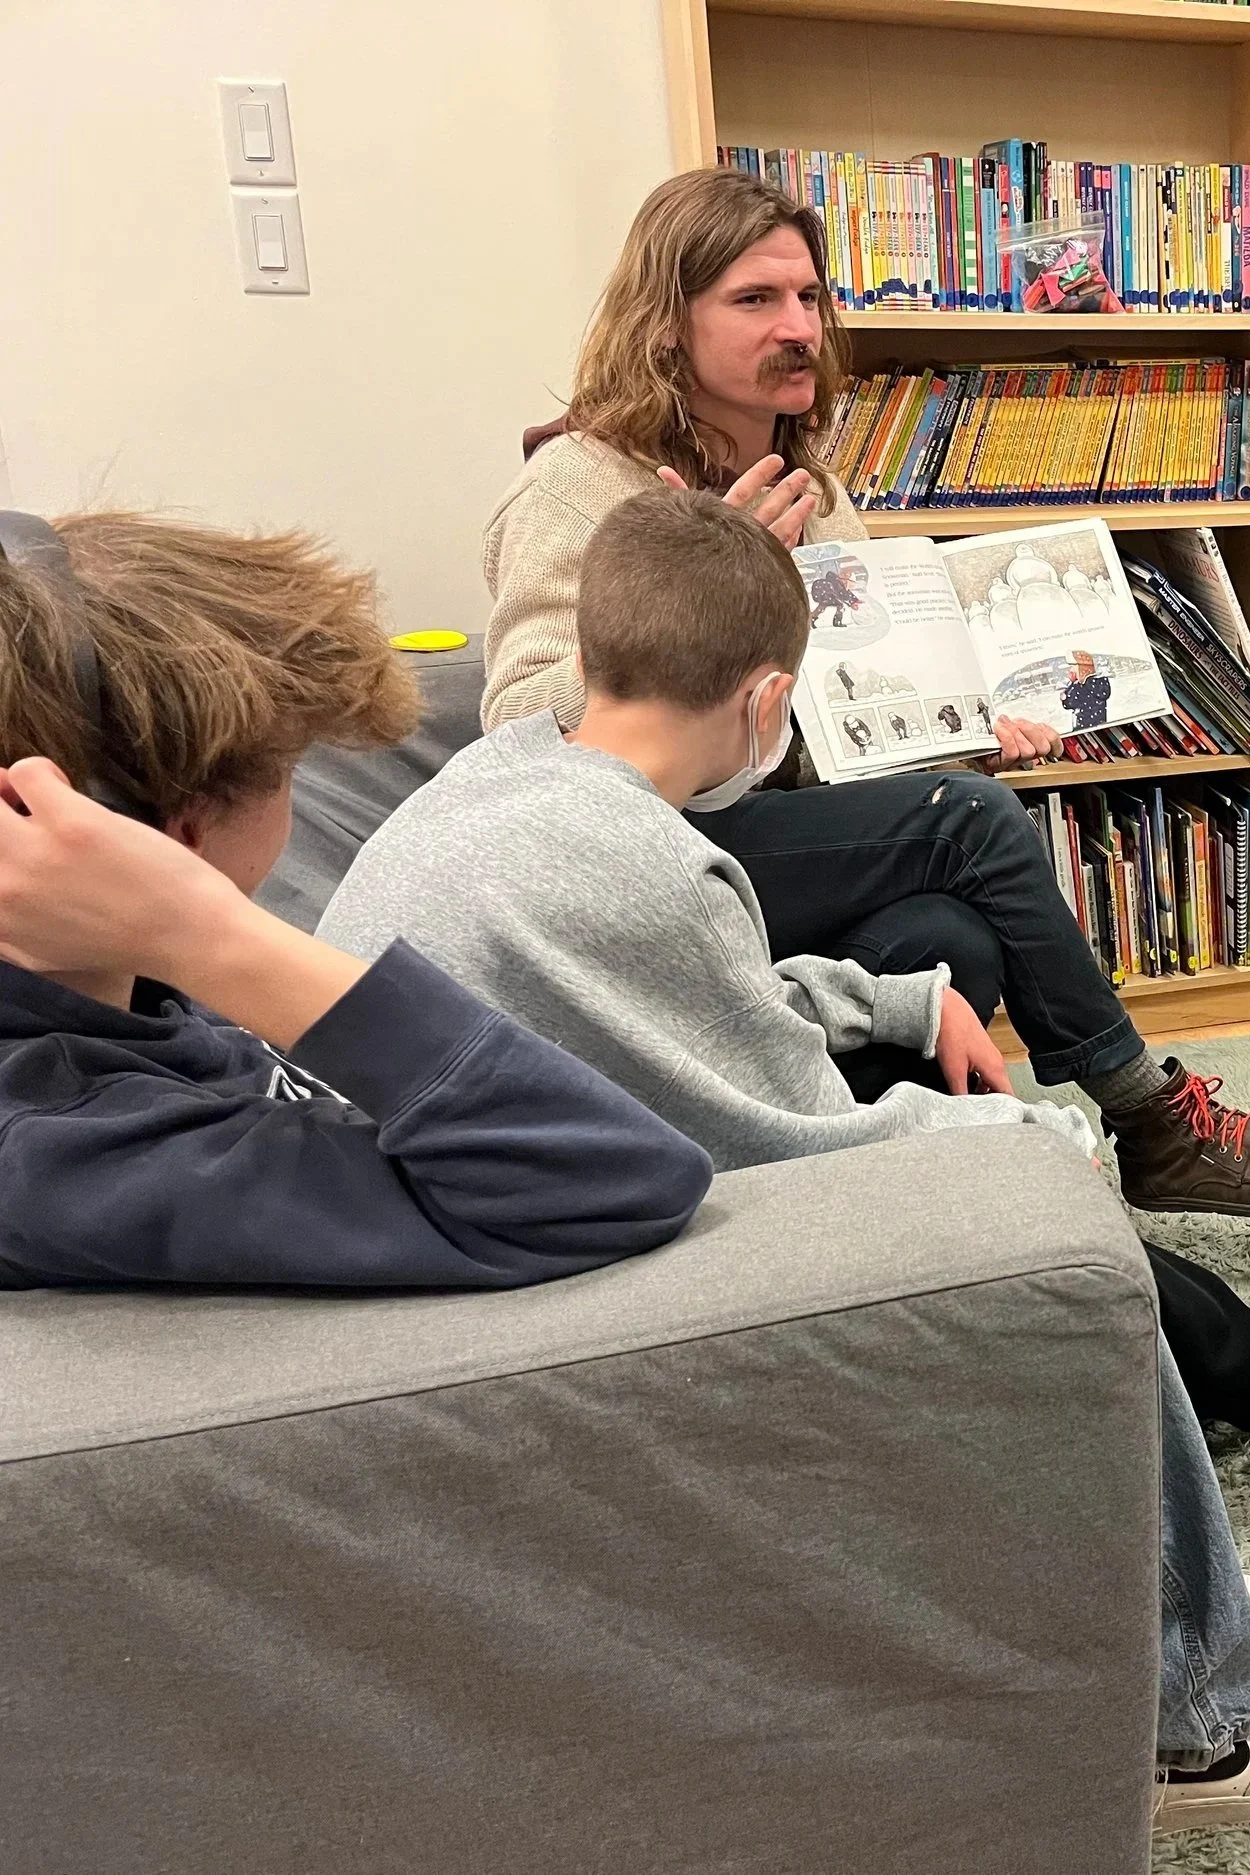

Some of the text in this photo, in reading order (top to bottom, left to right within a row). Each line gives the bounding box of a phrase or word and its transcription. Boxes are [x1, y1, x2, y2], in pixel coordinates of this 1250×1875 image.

[862, 237, 871, 254] Fudge
[1158, 585, 1181, 613] MASTER
[1178, 610, 1205, 643] ENGINEER
[1166, 618, 1204, 660] DINOSAURS
[1205, 640, 1248, 692] SKYSCRAPERS
